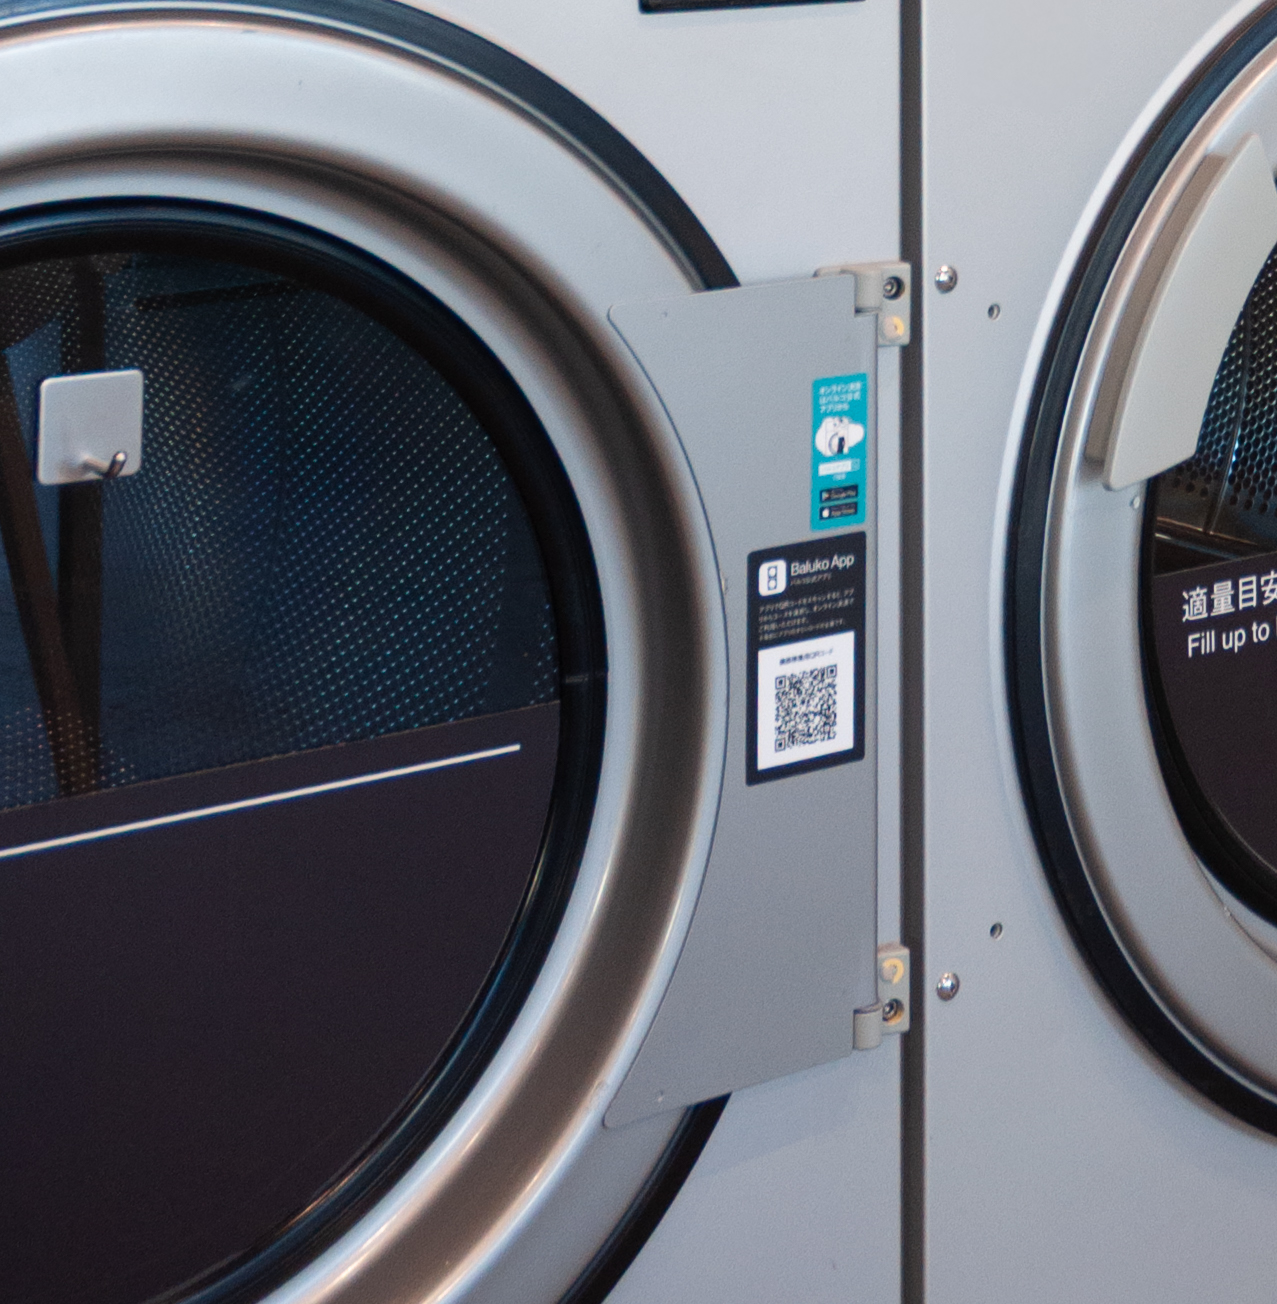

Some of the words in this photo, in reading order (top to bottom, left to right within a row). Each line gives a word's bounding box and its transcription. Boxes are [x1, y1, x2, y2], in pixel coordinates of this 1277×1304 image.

[790, 557, 829, 577] Baluko
[831, 553, 855, 570] App
[1188, 629, 1216, 658] Fill
[1222, 627, 1246, 653] up
[1252, 621, 1270, 643] to
